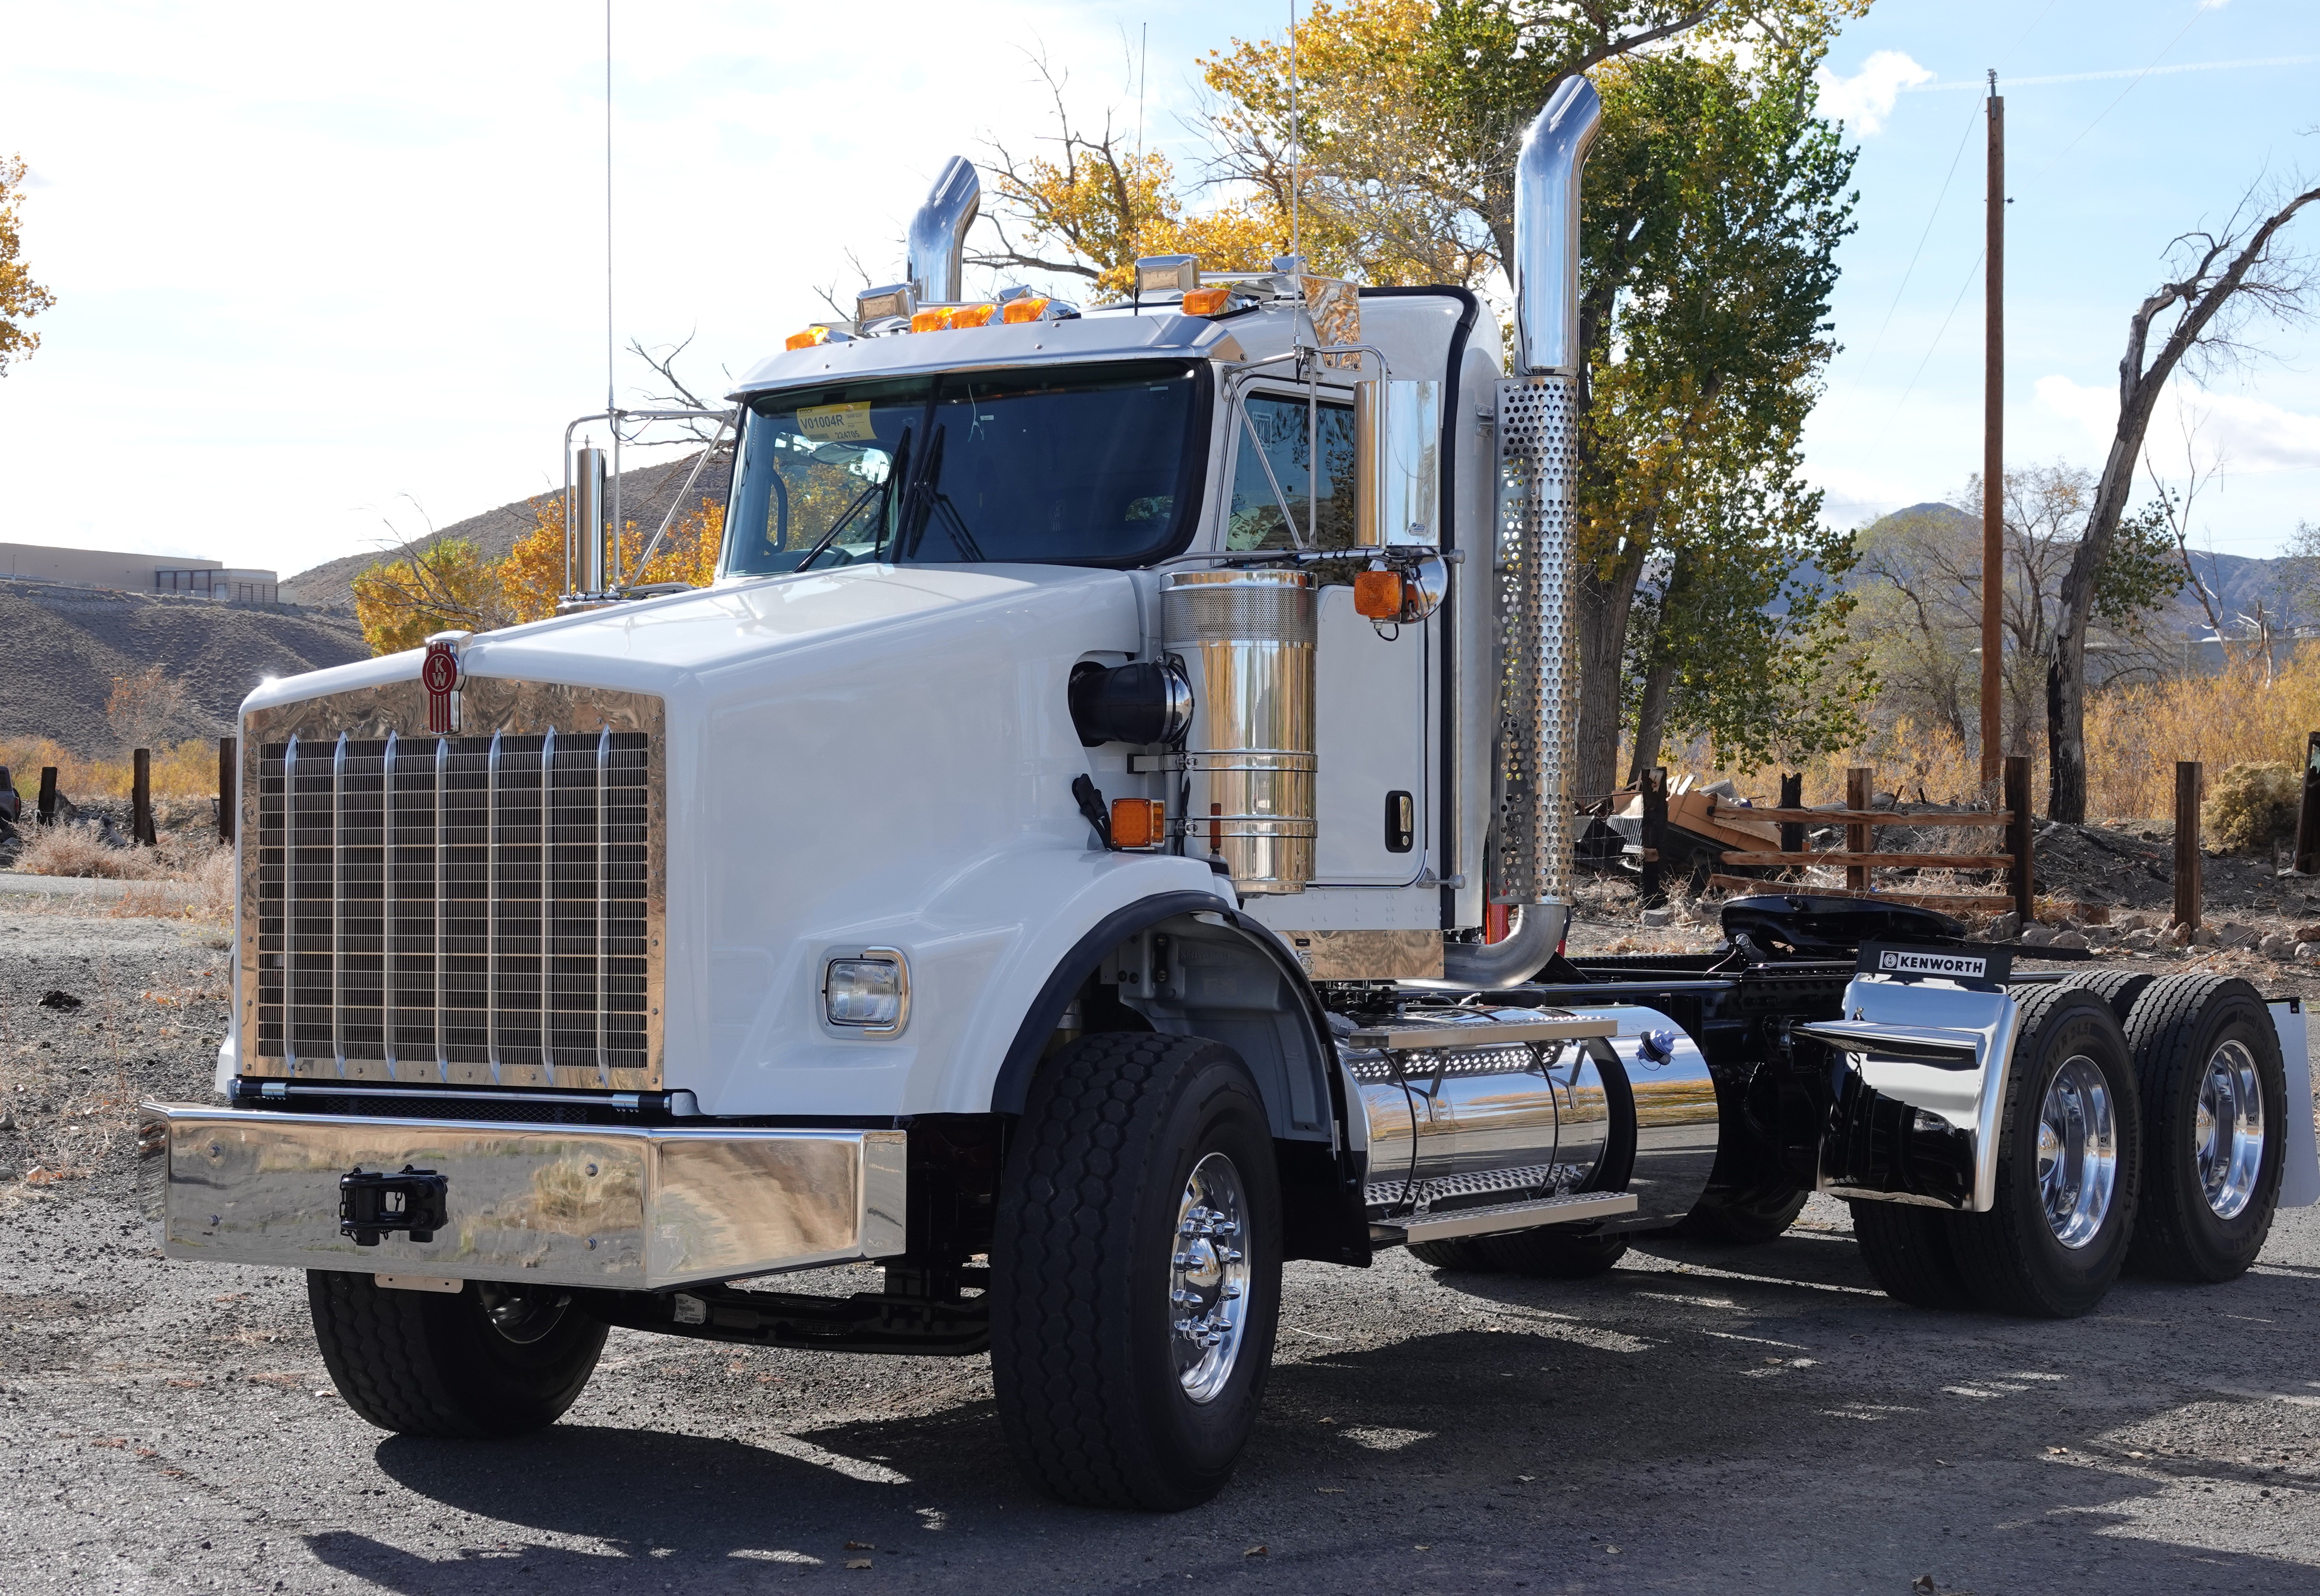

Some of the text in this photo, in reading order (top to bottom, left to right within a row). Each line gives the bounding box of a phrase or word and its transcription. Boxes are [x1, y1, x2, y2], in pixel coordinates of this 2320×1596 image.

[800, 415, 844, 429] V01004R
[835, 430, 860, 439] 224705
[435, 658, 445, 672] K
[432, 672, 447, 686] W
[1900, 956, 1983, 973] KENWORTH
[2239, 1009, 2257, 1029] Conti
[2061, 1034, 2068, 1049] R
[2070, 1022, 2089, 1040] 24.5
